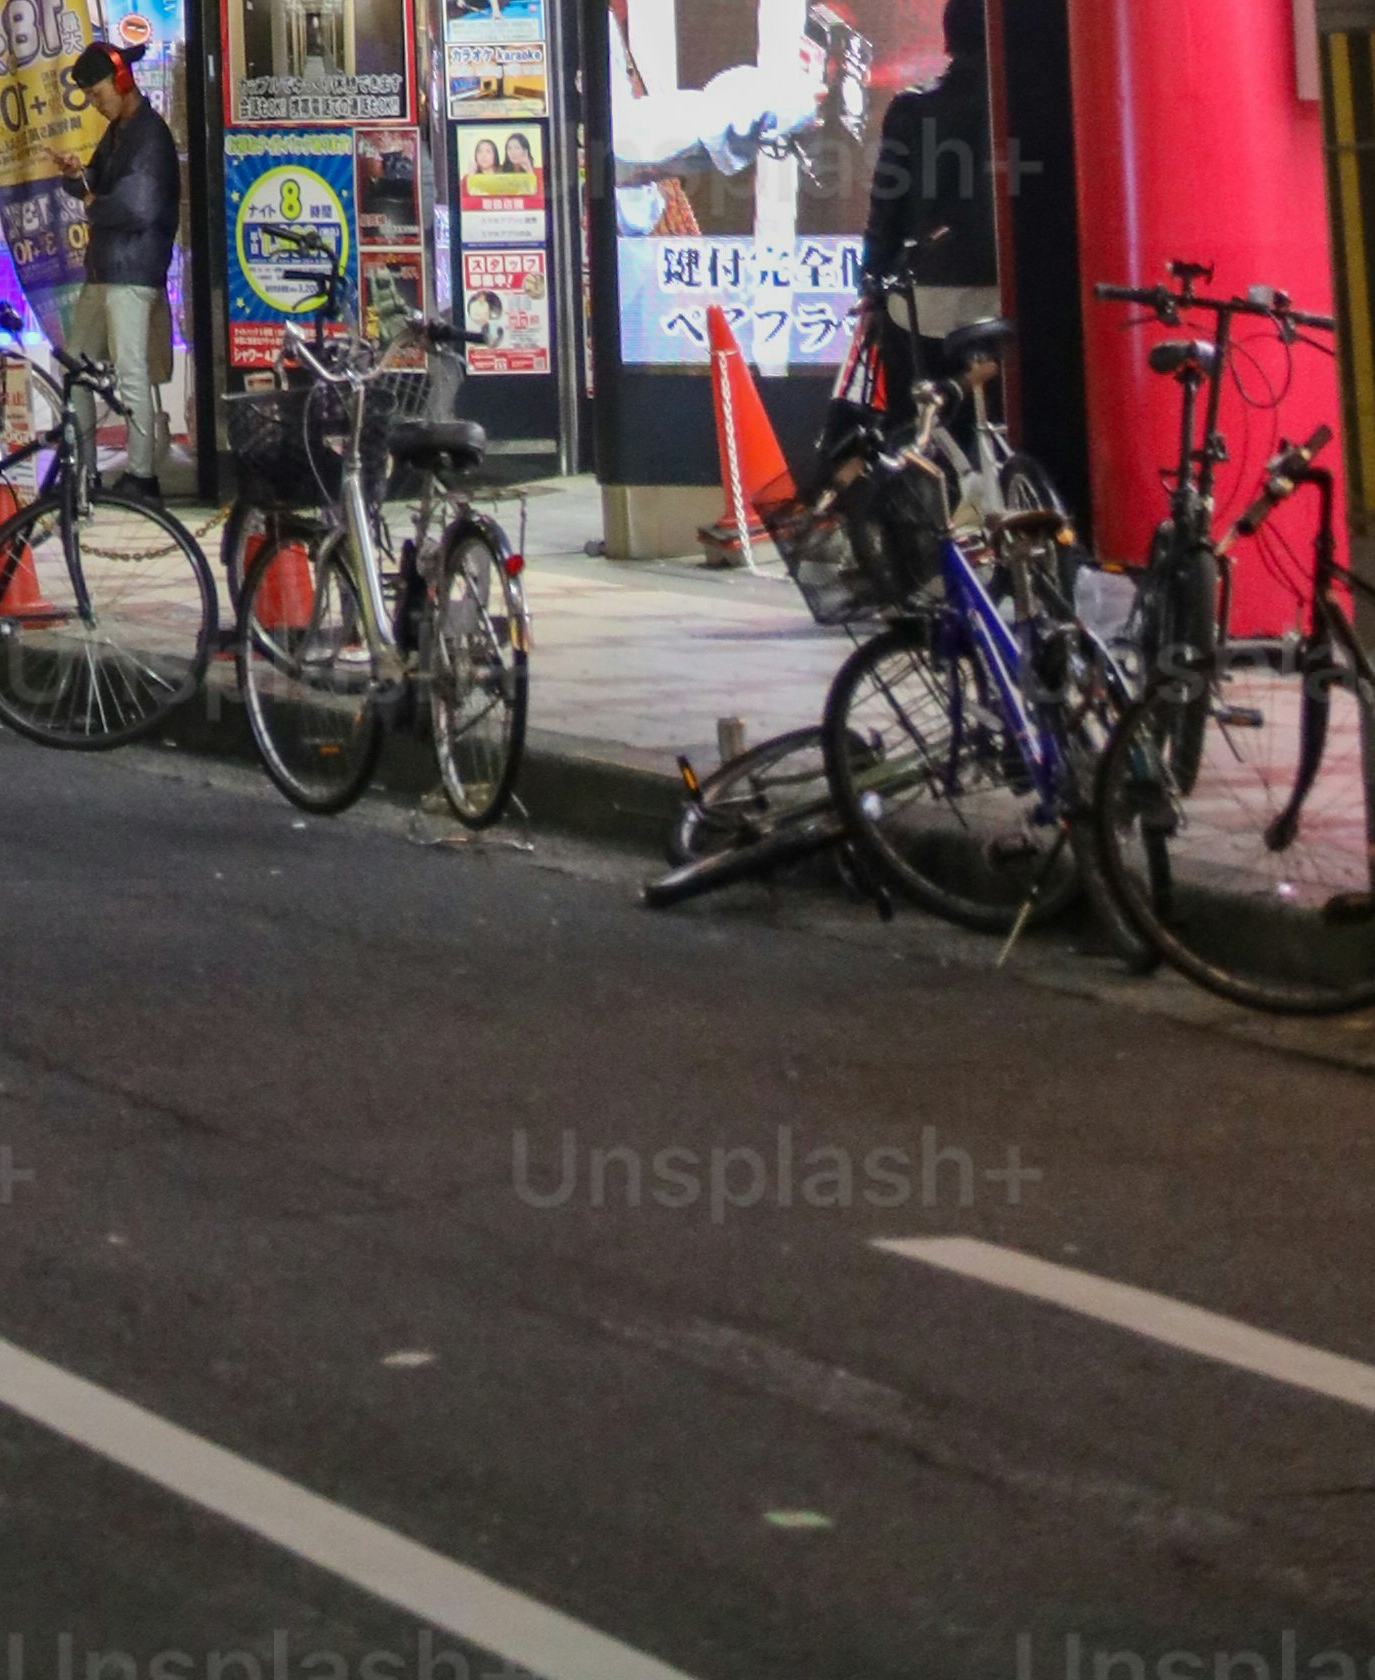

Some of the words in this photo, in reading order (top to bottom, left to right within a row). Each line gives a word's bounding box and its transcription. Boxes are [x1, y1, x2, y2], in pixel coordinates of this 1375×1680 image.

[452, 47, 495, 65] カラオケ
[496, 48, 542, 65] karaoke
[279, 177, 302, 221] 8
[469, 256, 539, 273] スタッフ
